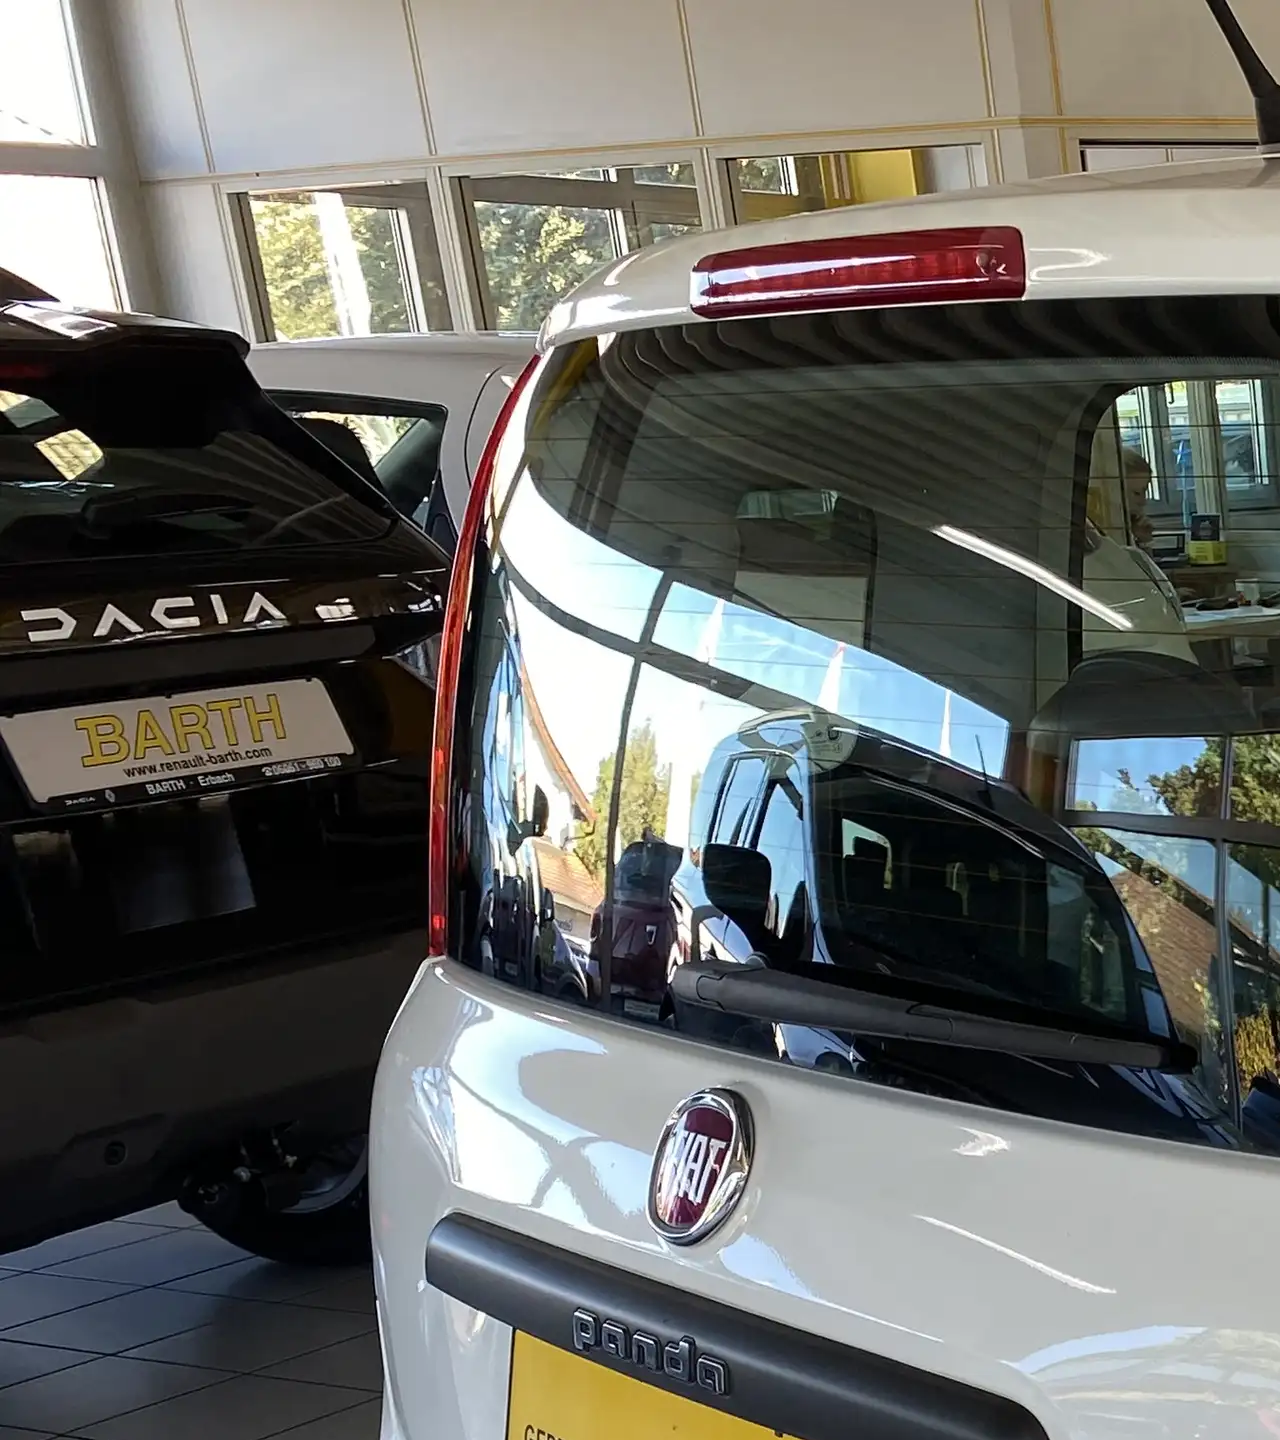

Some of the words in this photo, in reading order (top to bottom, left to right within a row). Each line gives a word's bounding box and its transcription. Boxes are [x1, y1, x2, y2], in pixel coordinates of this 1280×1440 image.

[20, 592, 287, 642] DACIA
[75, 694, 286, 768] BARTH
[124, 745, 272, 778] www.renault-barth.com
[146, 779, 186, 795] BARTH
[197, 772, 236, 787] Erbach
[658, 1130, 727, 1205] FIAT
[573, 1308, 730, 1396] panda
